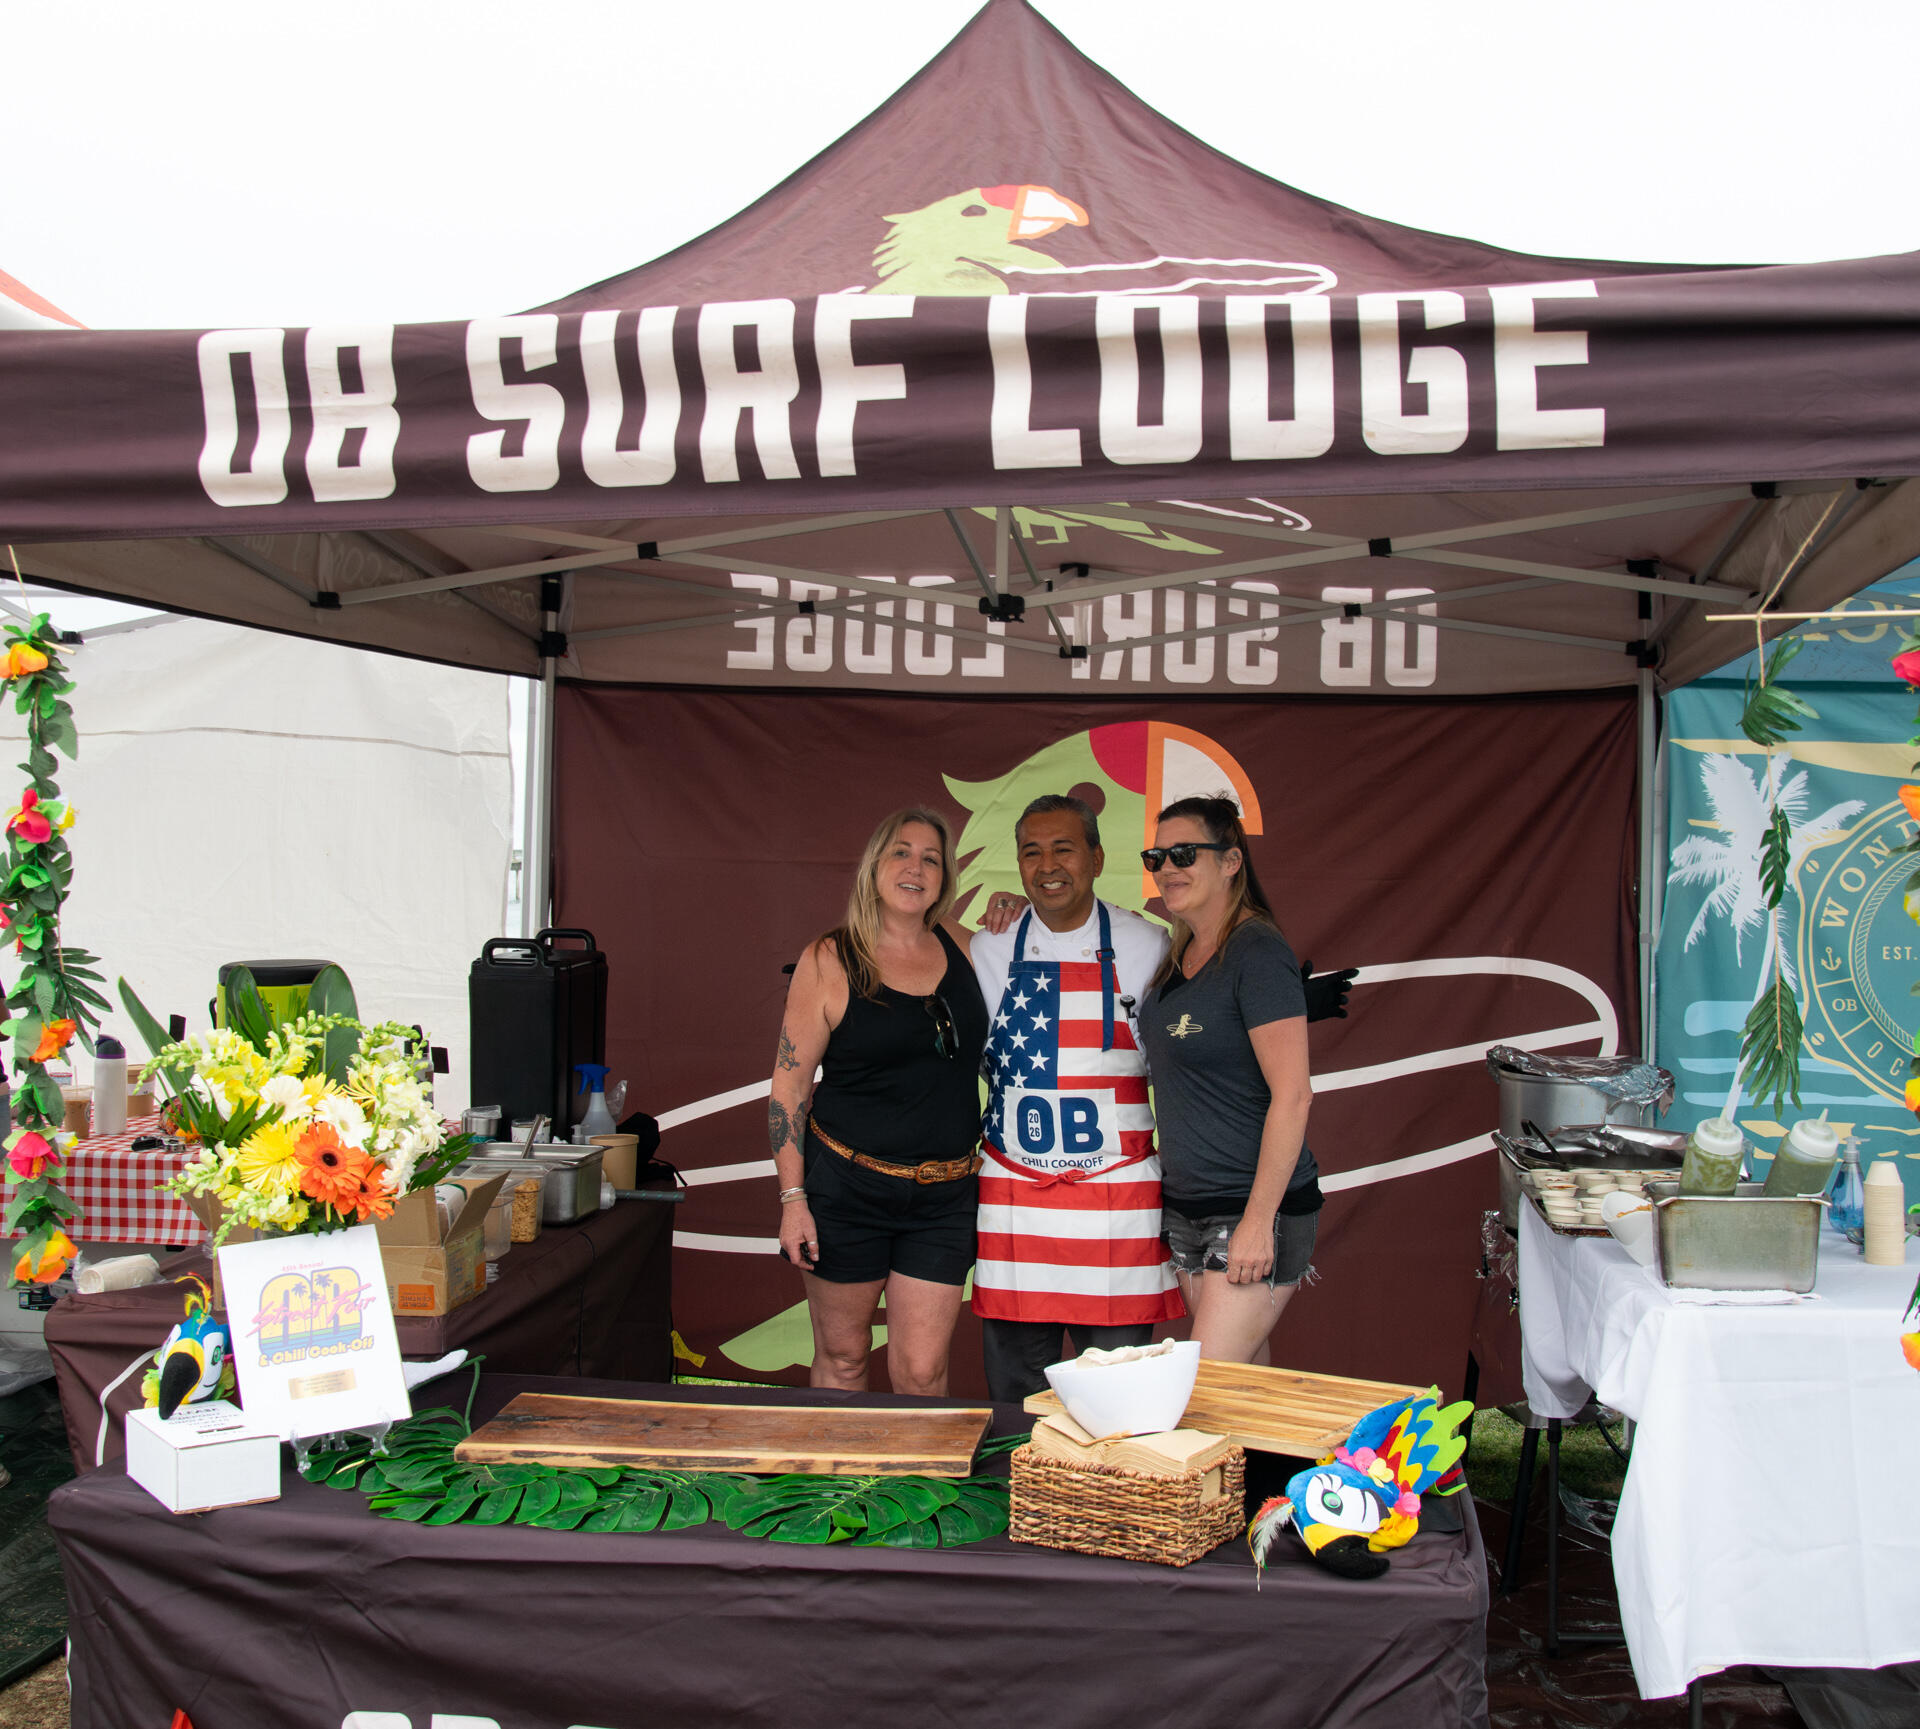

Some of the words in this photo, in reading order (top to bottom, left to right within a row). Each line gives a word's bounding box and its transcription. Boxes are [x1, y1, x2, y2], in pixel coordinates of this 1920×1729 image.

[198, 324, 400, 507] OB
[465, 294, 916, 493] SURF
[987, 279, 1606, 471] LODGE
[1882, 946, 1918, 961] EST.
[1832, 998, 1858, 1012] OB
[1016, 1095, 1104, 1154] OB
[1028, 1113, 1039, 1124] 20
[1029, 1127, 1040, 1138] 26
[1021, 1157, 1049, 1168] CHILI
[1050, 1156, 1104, 1169] COOKOFF
[258, 1353, 270, 1367] &
[271, 1346, 307, 1365] Chili
[307, 1335, 375, 1359] Cook-Off
